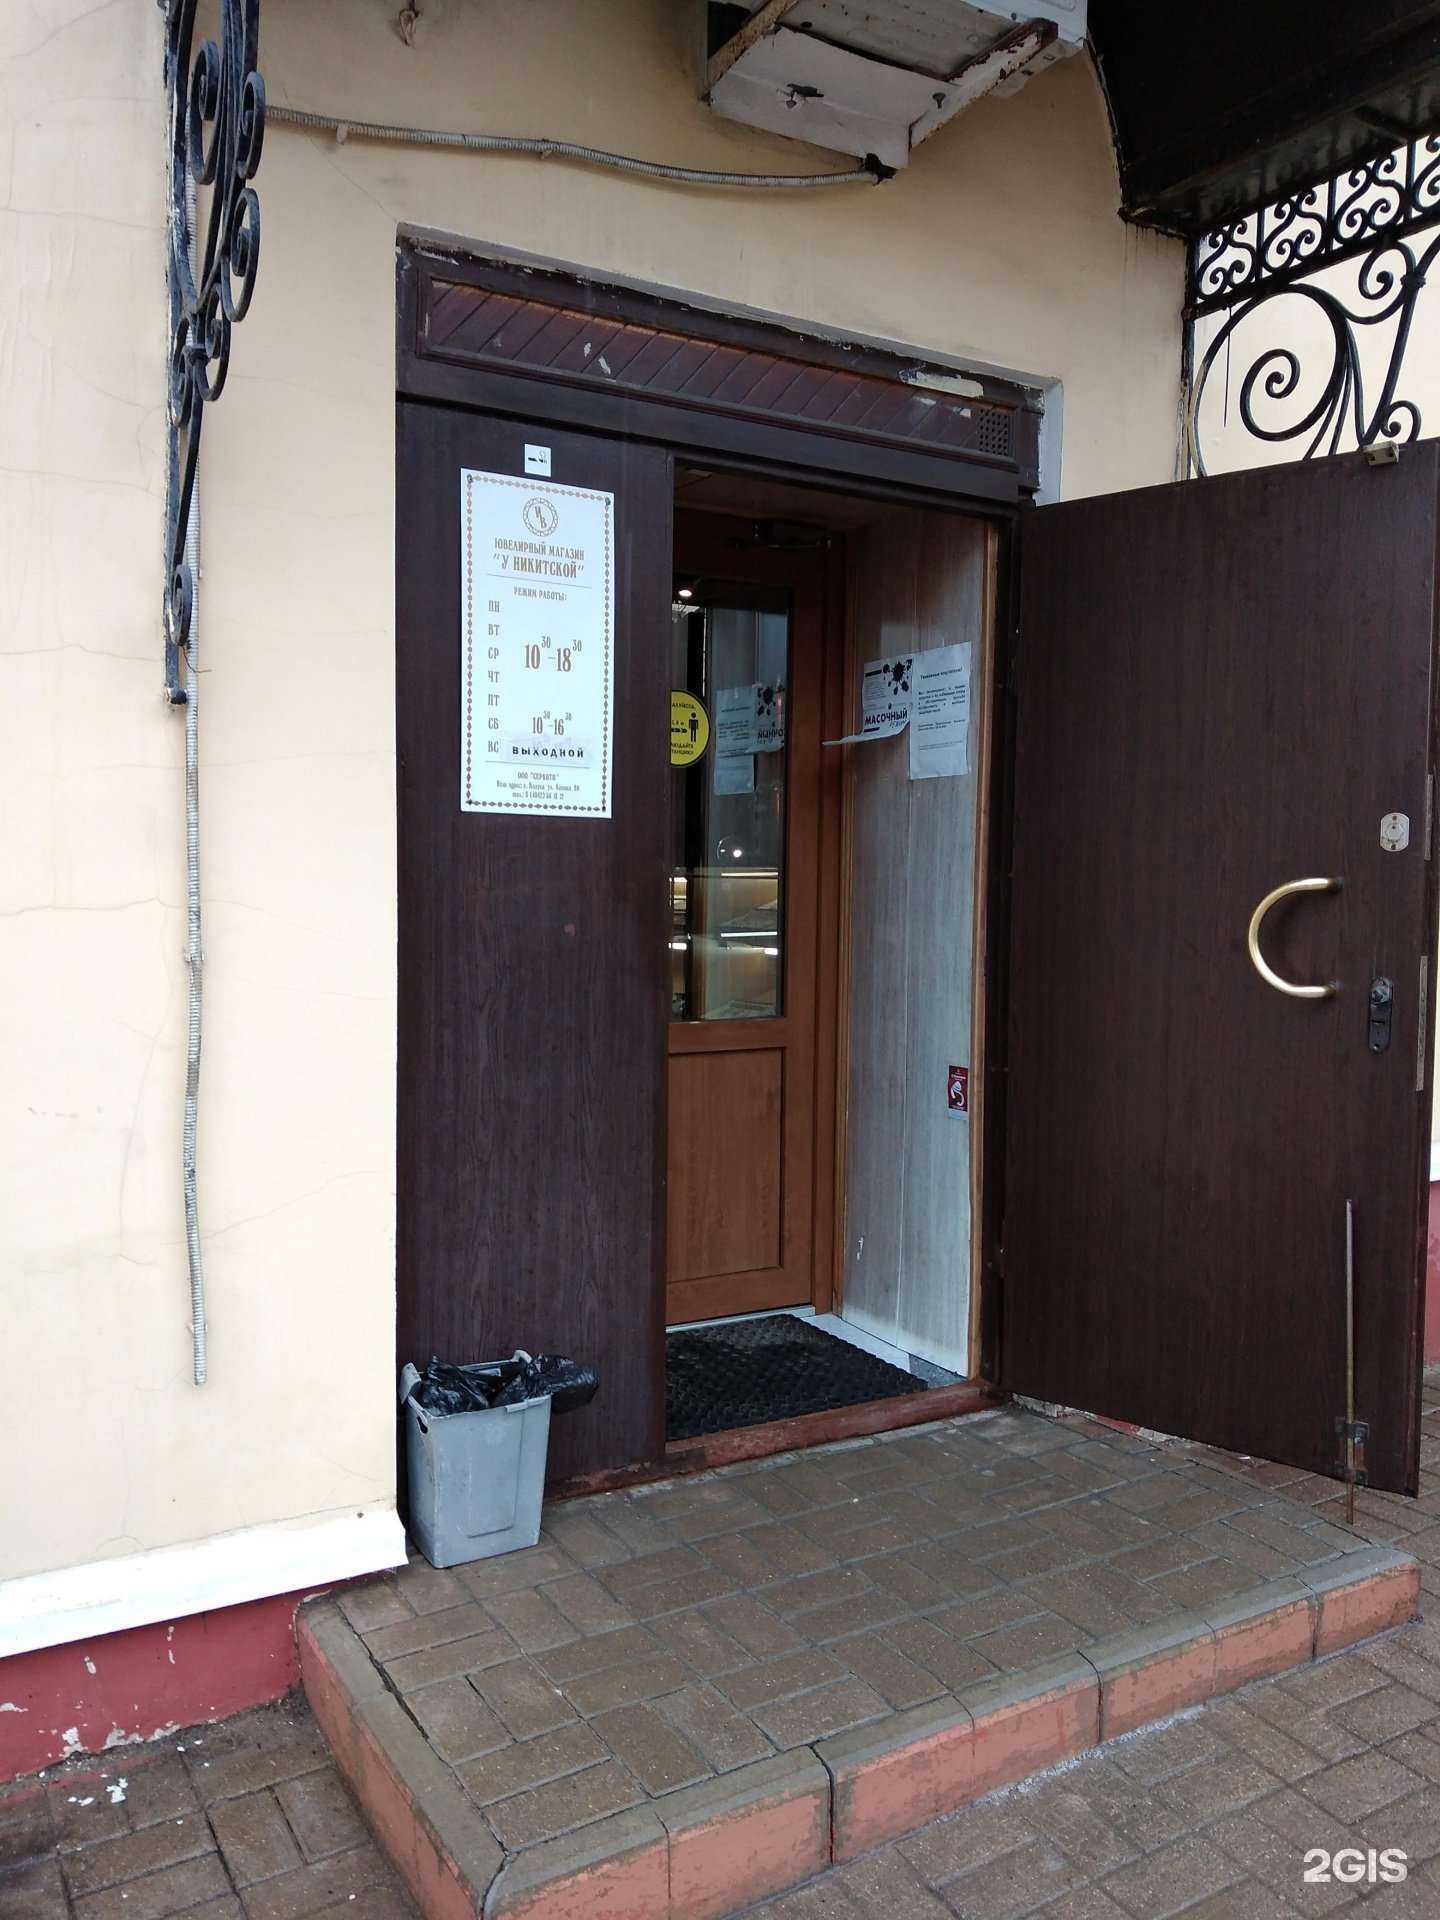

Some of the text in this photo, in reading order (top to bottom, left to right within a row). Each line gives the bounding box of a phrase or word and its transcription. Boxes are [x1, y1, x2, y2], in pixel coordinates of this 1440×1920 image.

[494, 537, 585, 561] ЮВЕЛИРНЫЙ МАГАЗИН
[513, 586, 567, 601] РЕЖИМ РАБОТЫ:
[488, 600, 500, 613] ПН
[488, 624, 500, 636] ВТ
[488, 647, 499, 659] СР
[488, 670, 500, 683] ЧТ
[488, 694, 500, 706] ПТ
[864, 707, 908, 726] МАСОЧНЫЙ
[488, 717, 499, 730] СБ
[488, 740, 499, 753] ВС
